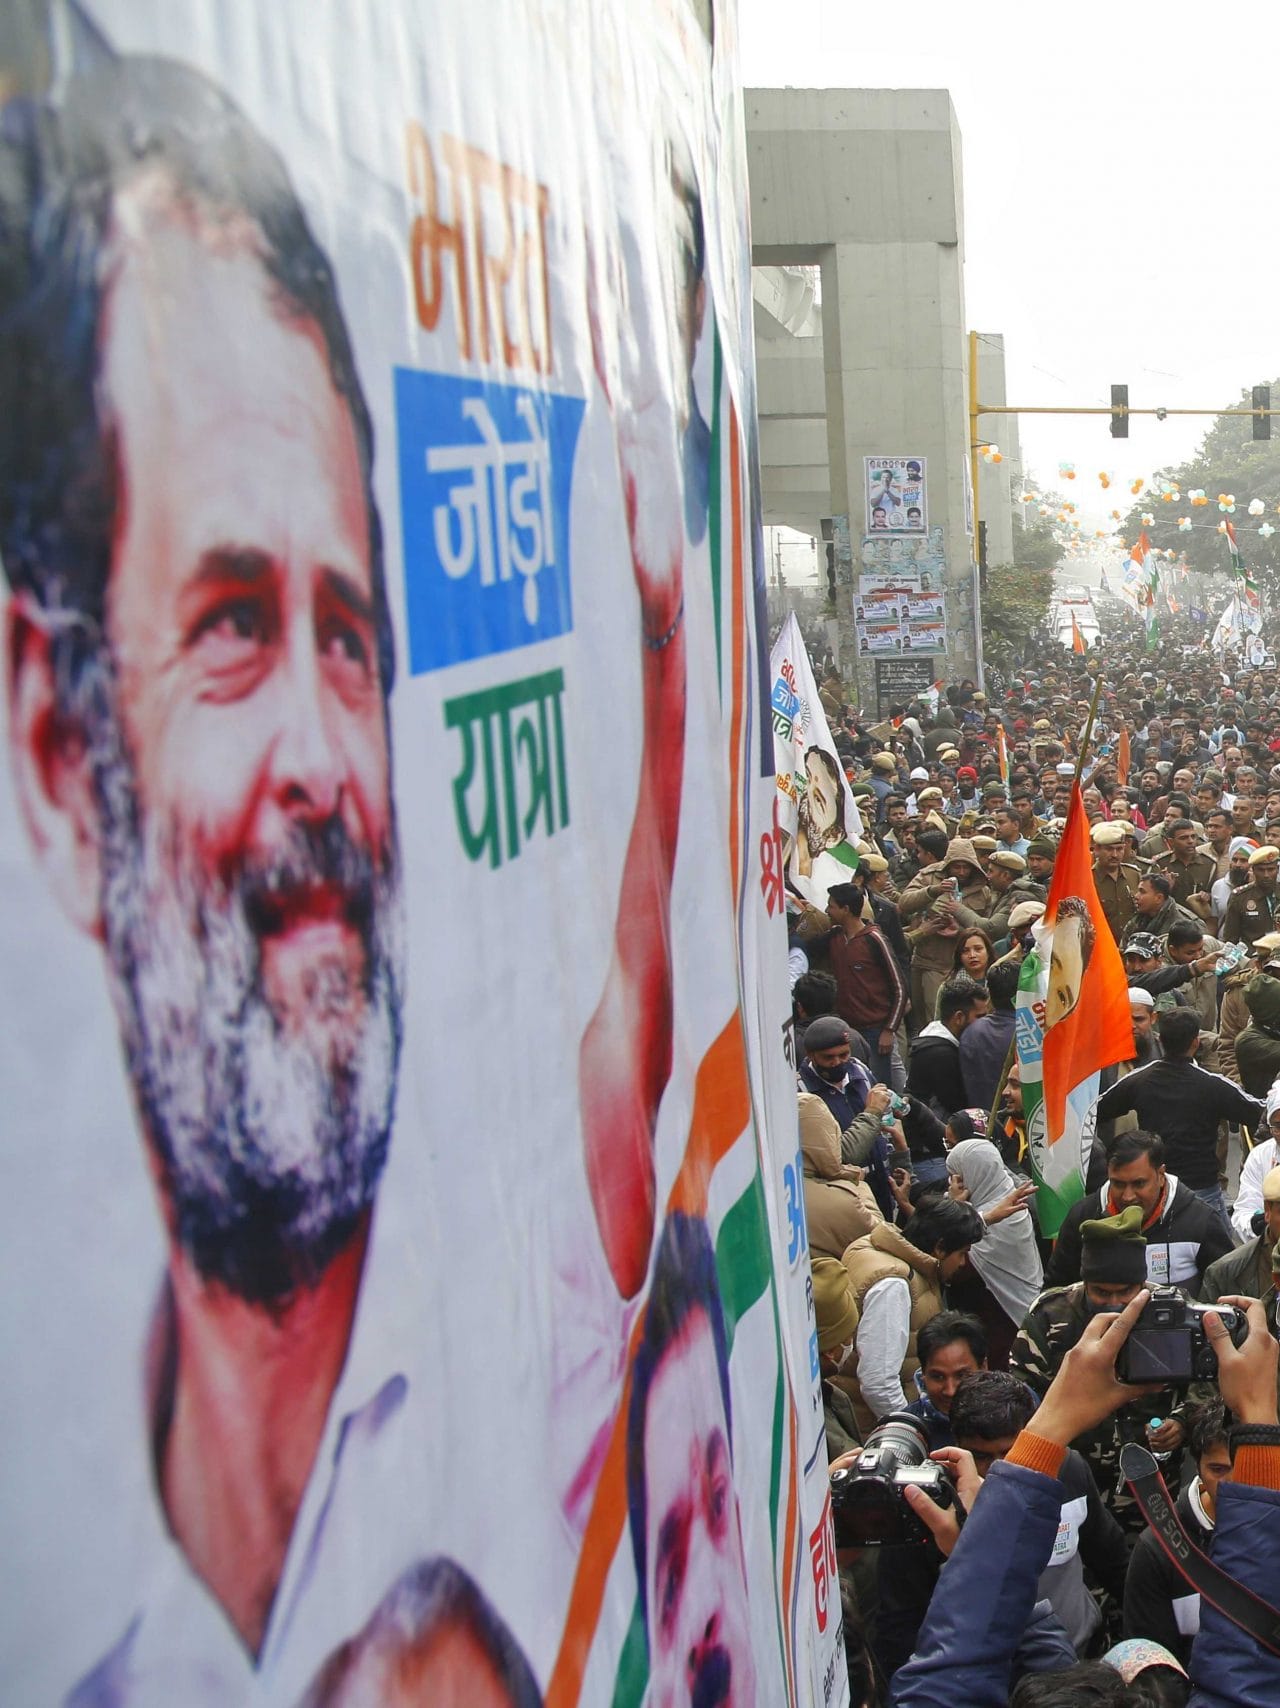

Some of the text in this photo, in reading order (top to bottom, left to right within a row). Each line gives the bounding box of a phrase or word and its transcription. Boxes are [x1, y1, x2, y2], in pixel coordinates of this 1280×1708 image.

[405, 119, 553, 376] भारत
[426, 398, 558, 625] जोड़ो
[443, 668, 570, 870] यात्रा
[1162, 1519, 1190, 1560] EOS
